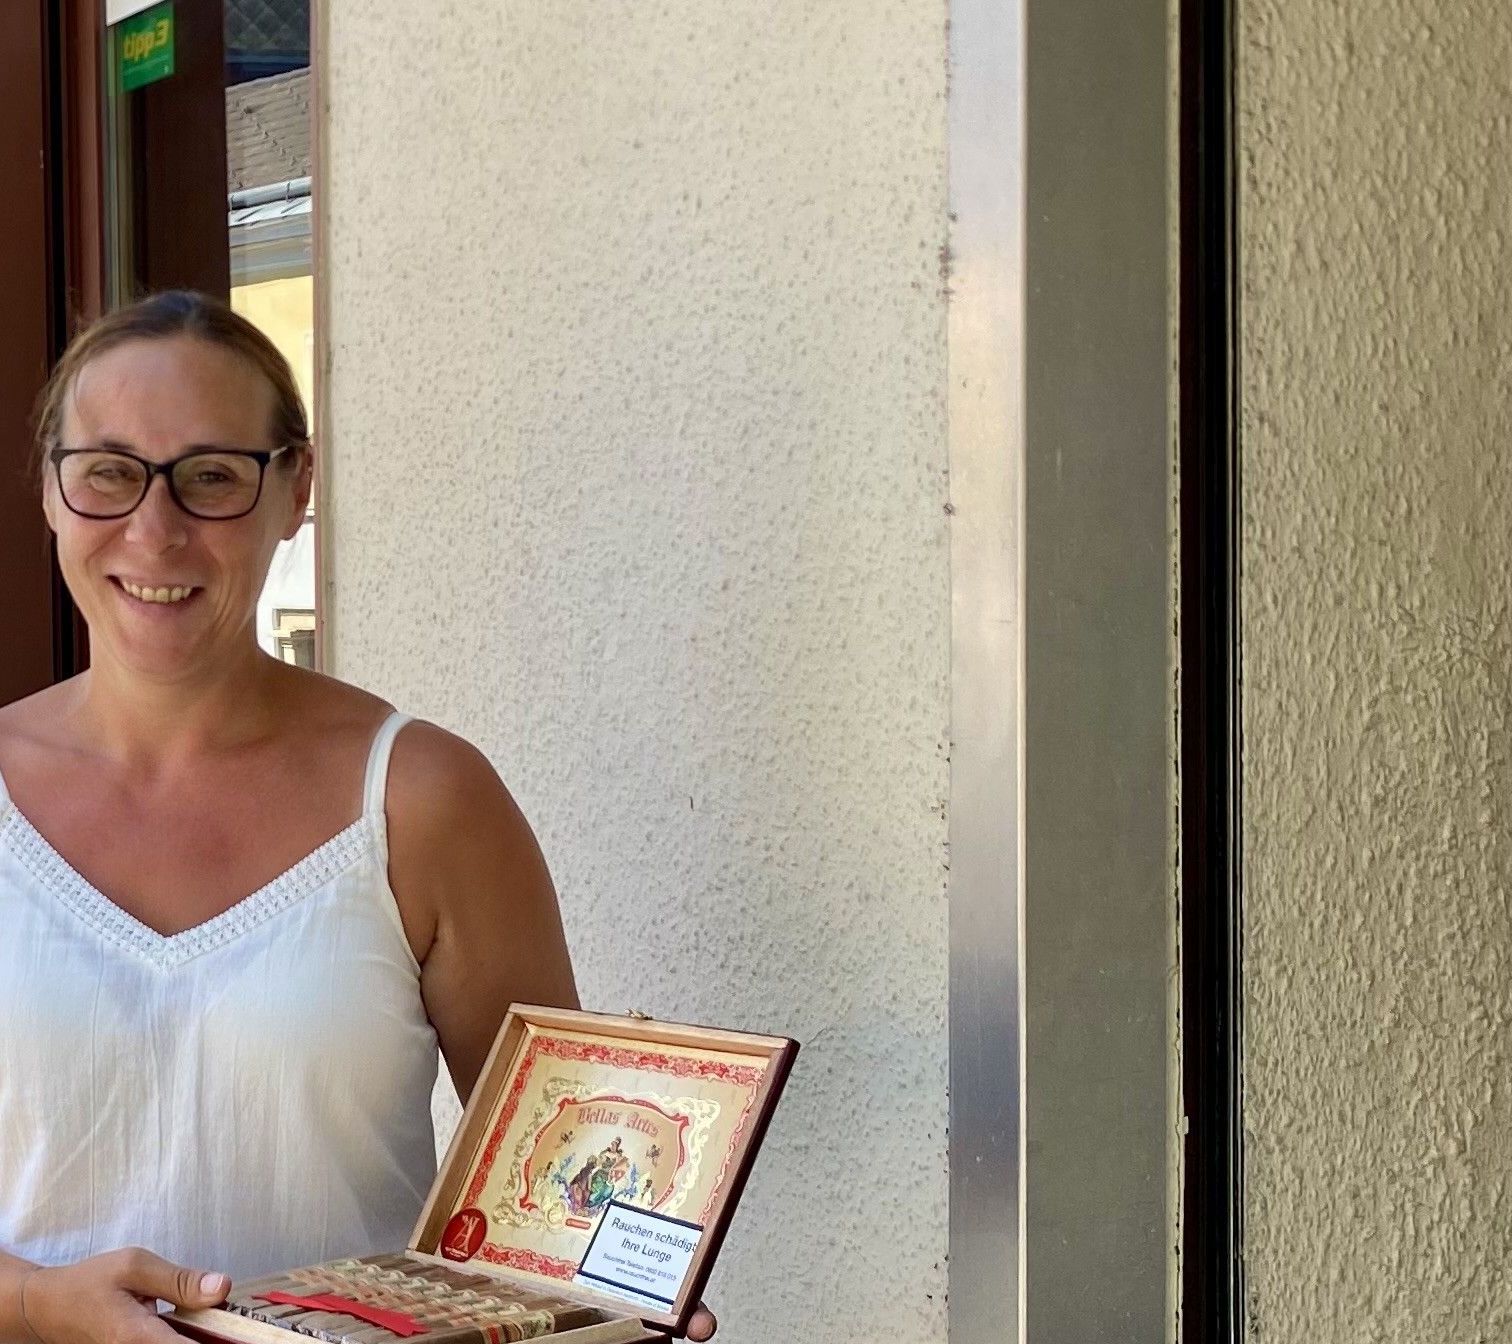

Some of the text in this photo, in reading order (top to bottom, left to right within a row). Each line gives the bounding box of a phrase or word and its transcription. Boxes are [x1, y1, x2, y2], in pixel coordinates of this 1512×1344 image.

[123, 18, 168, 61] tipp3
[611, 1217, 653, 1239] Rauchen
[621, 1237, 672, 1263] Ihre Lunge
